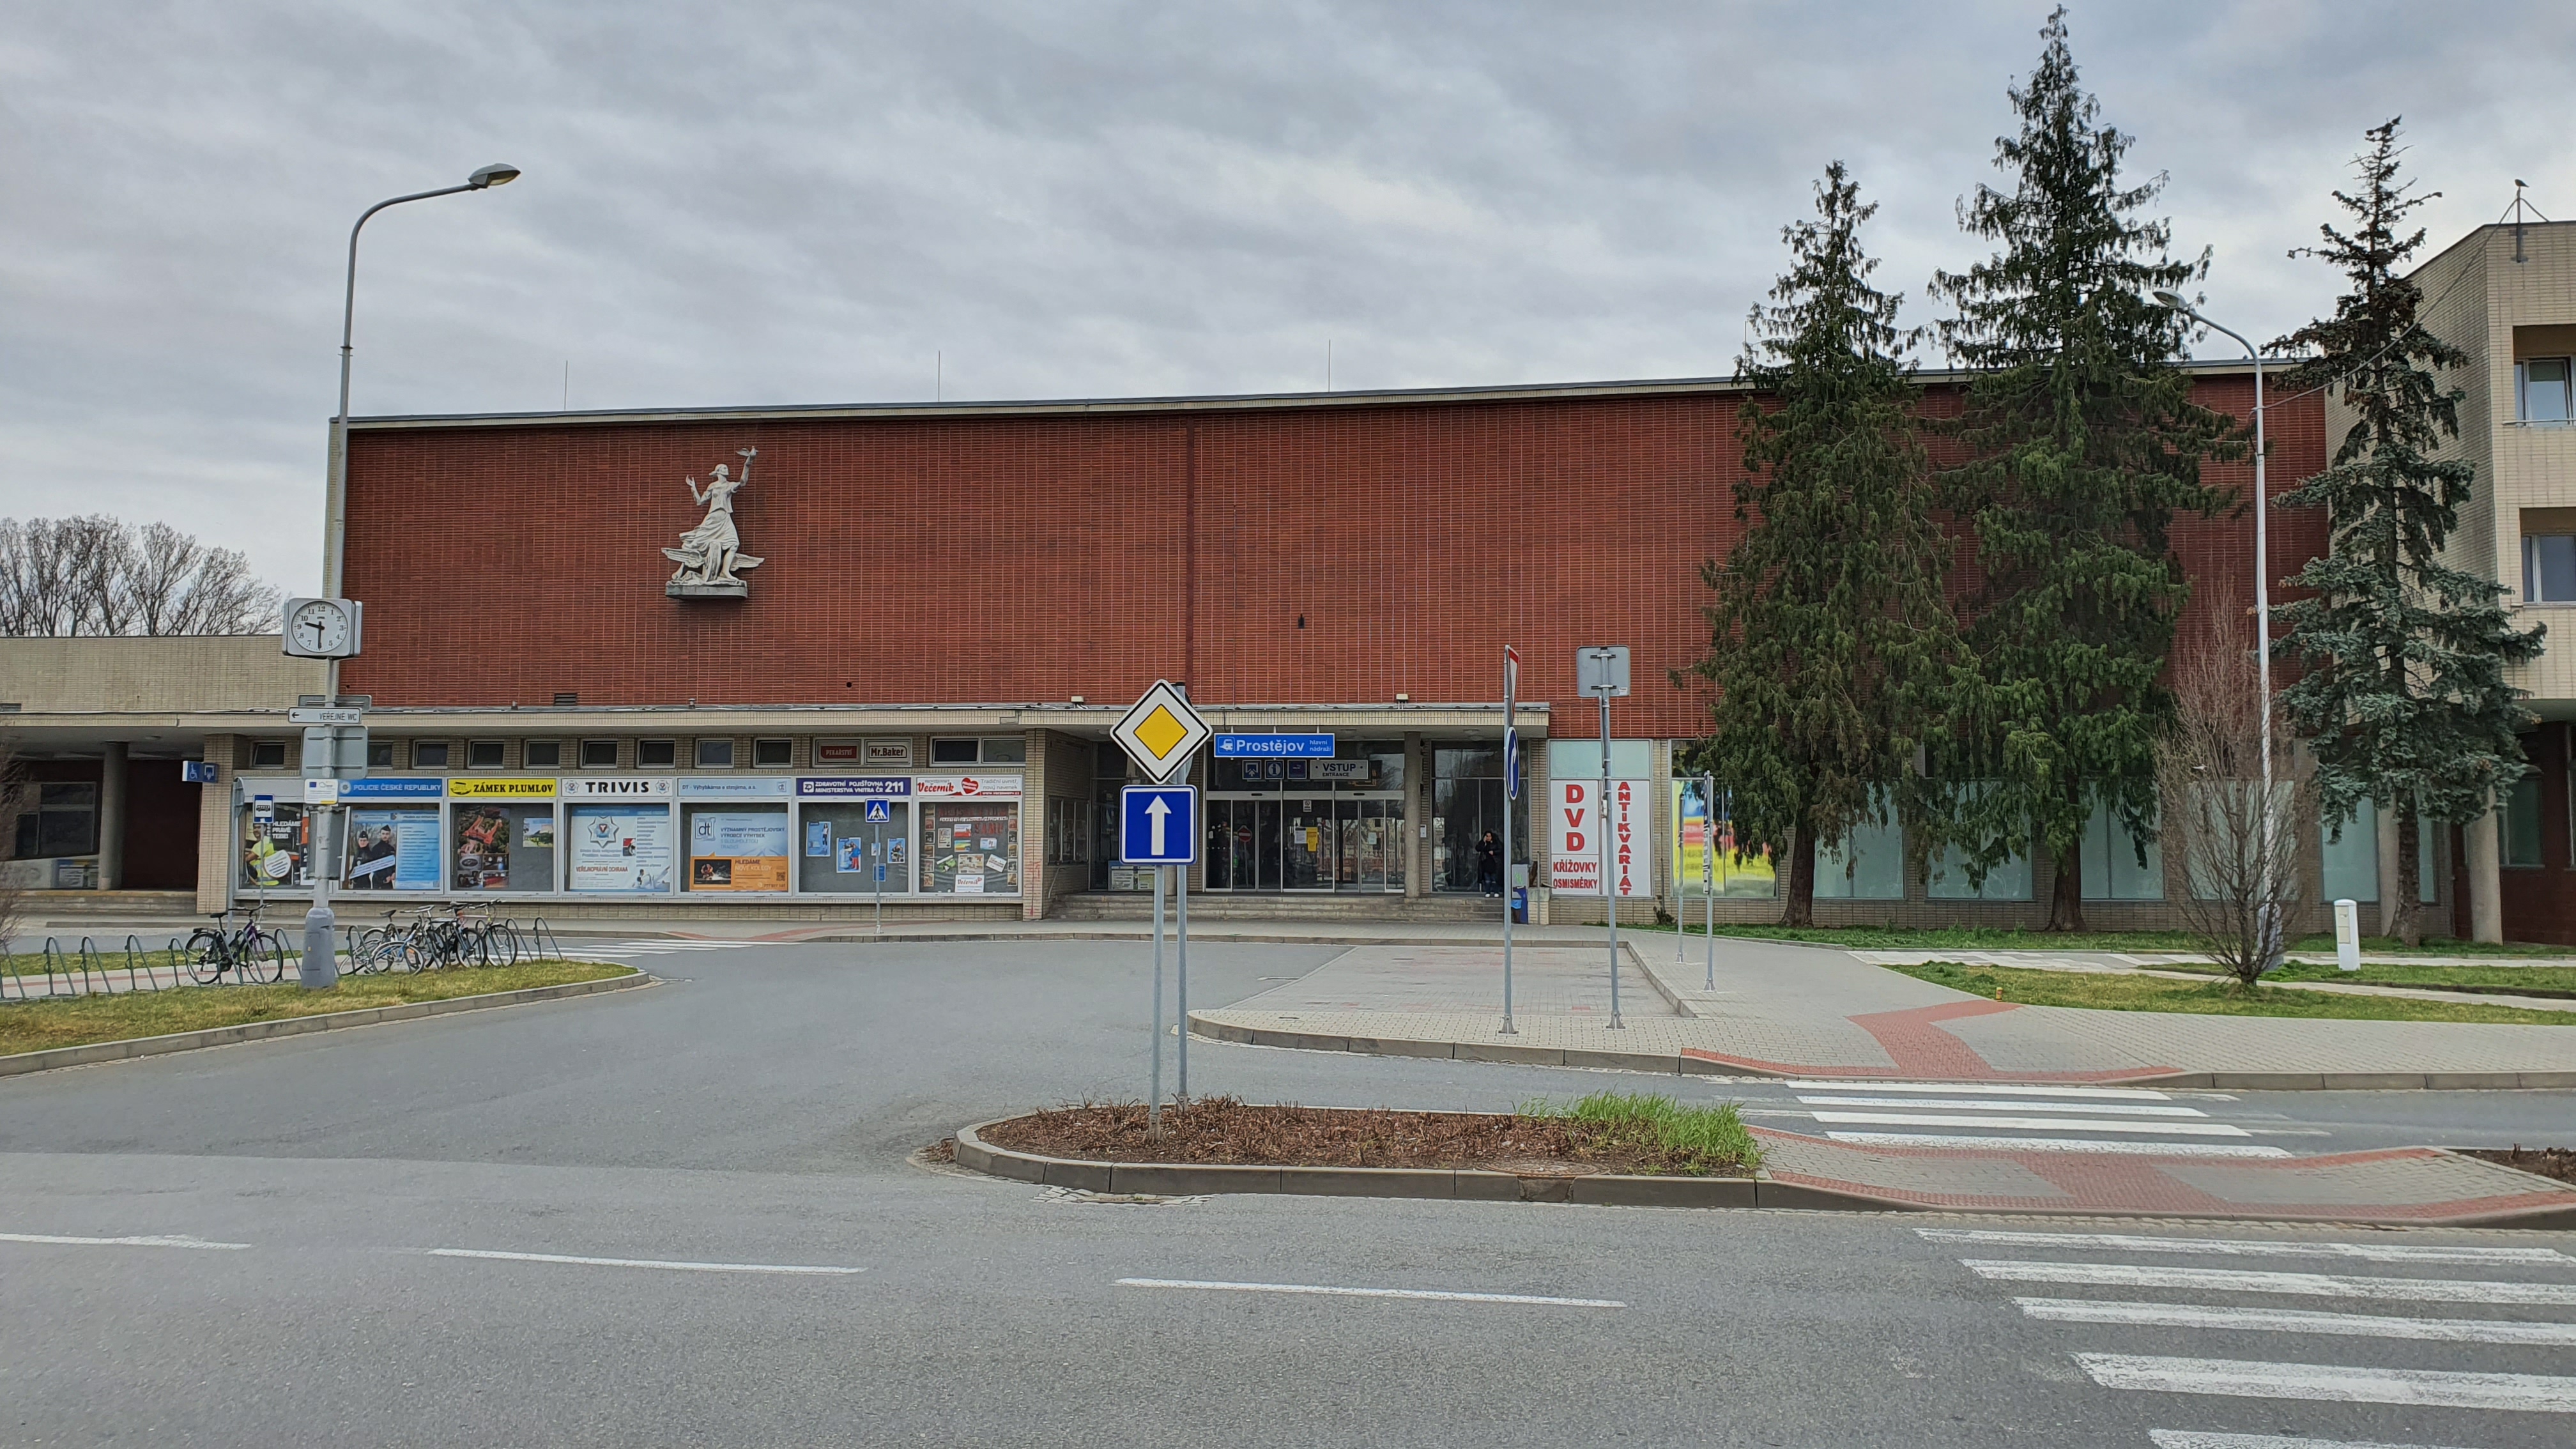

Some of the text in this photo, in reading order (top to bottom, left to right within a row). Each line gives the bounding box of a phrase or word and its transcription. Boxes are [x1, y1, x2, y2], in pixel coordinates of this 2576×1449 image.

[319, 710, 345, 721] VEŘEJNÉ
[871, 747, 903, 756] Mr.Baker
[1236, 739, 1305, 755] Prostějov
[1322, 763, 1356, 772] VSTUP
[473, 781, 554, 793] ZÁMEK PLUMLOV
[585, 781, 649, 793] TRIVIS
[885, 781, 904, 793] 211
[917, 782, 954, 792] Večerník
[1564, 784, 1585, 851] DVD
[699, 822, 711, 836] dt
[1618, 781, 1632, 896] ANTIKVARIÁT
[1553, 859, 1597, 873] KŘÍŽOVKY
[1553, 877, 1597, 889] OSMISMĚRKY
